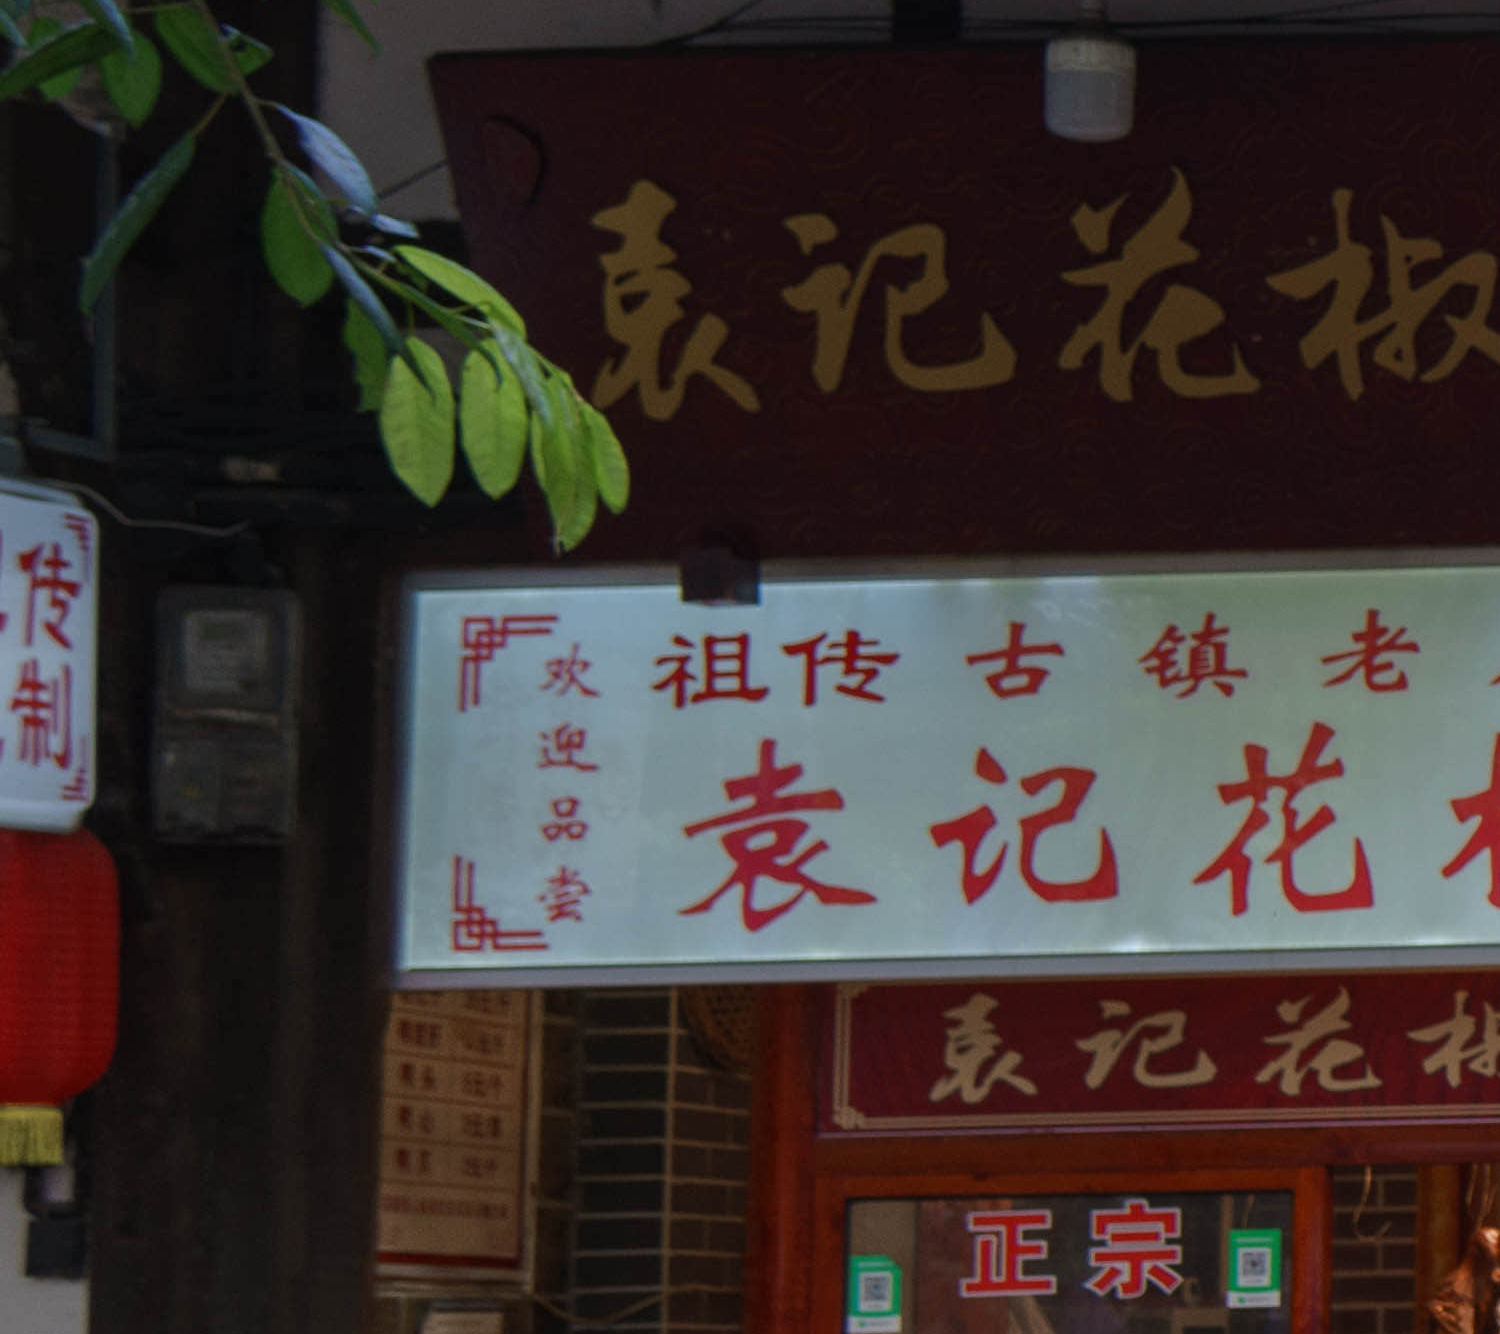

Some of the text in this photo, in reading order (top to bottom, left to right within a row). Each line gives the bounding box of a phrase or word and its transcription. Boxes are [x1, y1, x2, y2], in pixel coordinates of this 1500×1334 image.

[0, 541, 82, 650] 传
[0, 659, 72, 770] 制
[535, 643, 602, 923] 欢迎品尝
[959, 1199, 1183, 1299] 正宗
